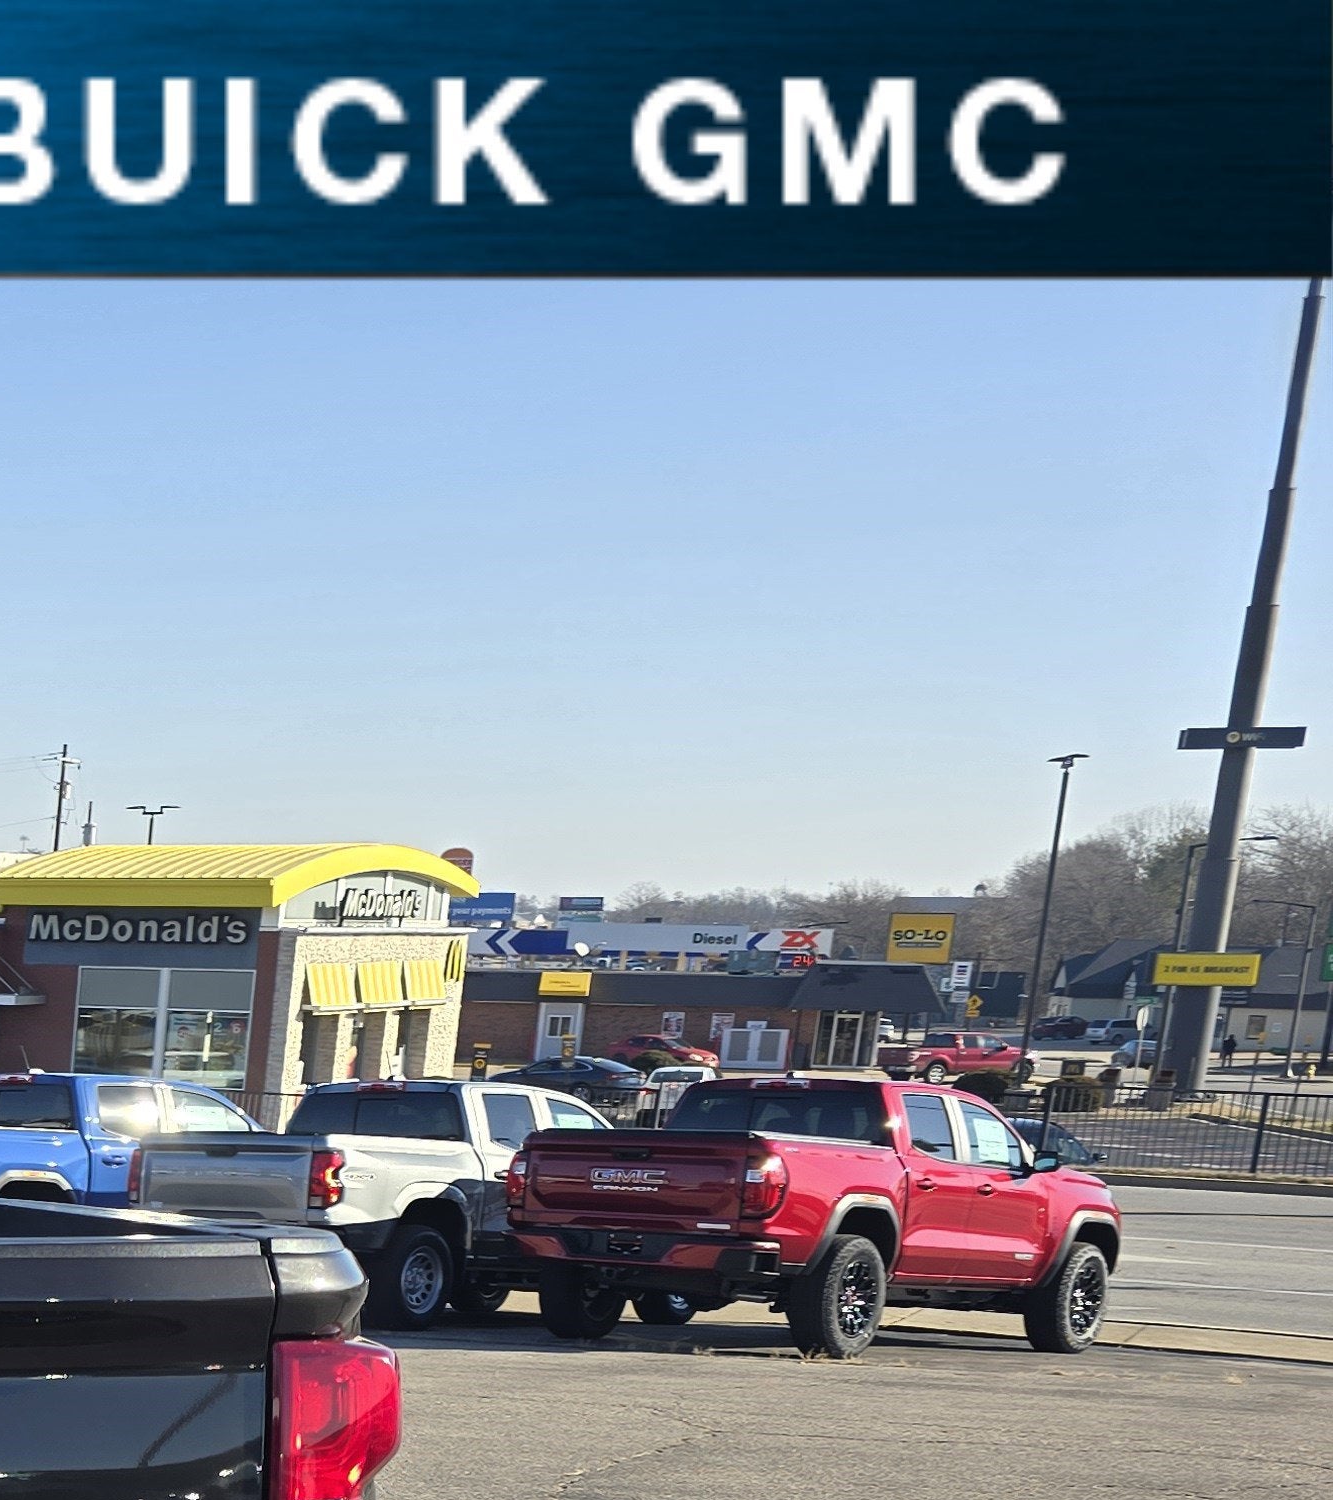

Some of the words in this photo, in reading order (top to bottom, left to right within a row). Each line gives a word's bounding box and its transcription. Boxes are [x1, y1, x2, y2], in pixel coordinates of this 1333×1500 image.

[28, 913, 248, 944] McDonald's
[893, 929, 947, 941] SO-LO
[692, 932, 738, 945] Diesel
[590, 1168, 667, 1185] GMC
[592, 1184, 659, 1193] CANYON
